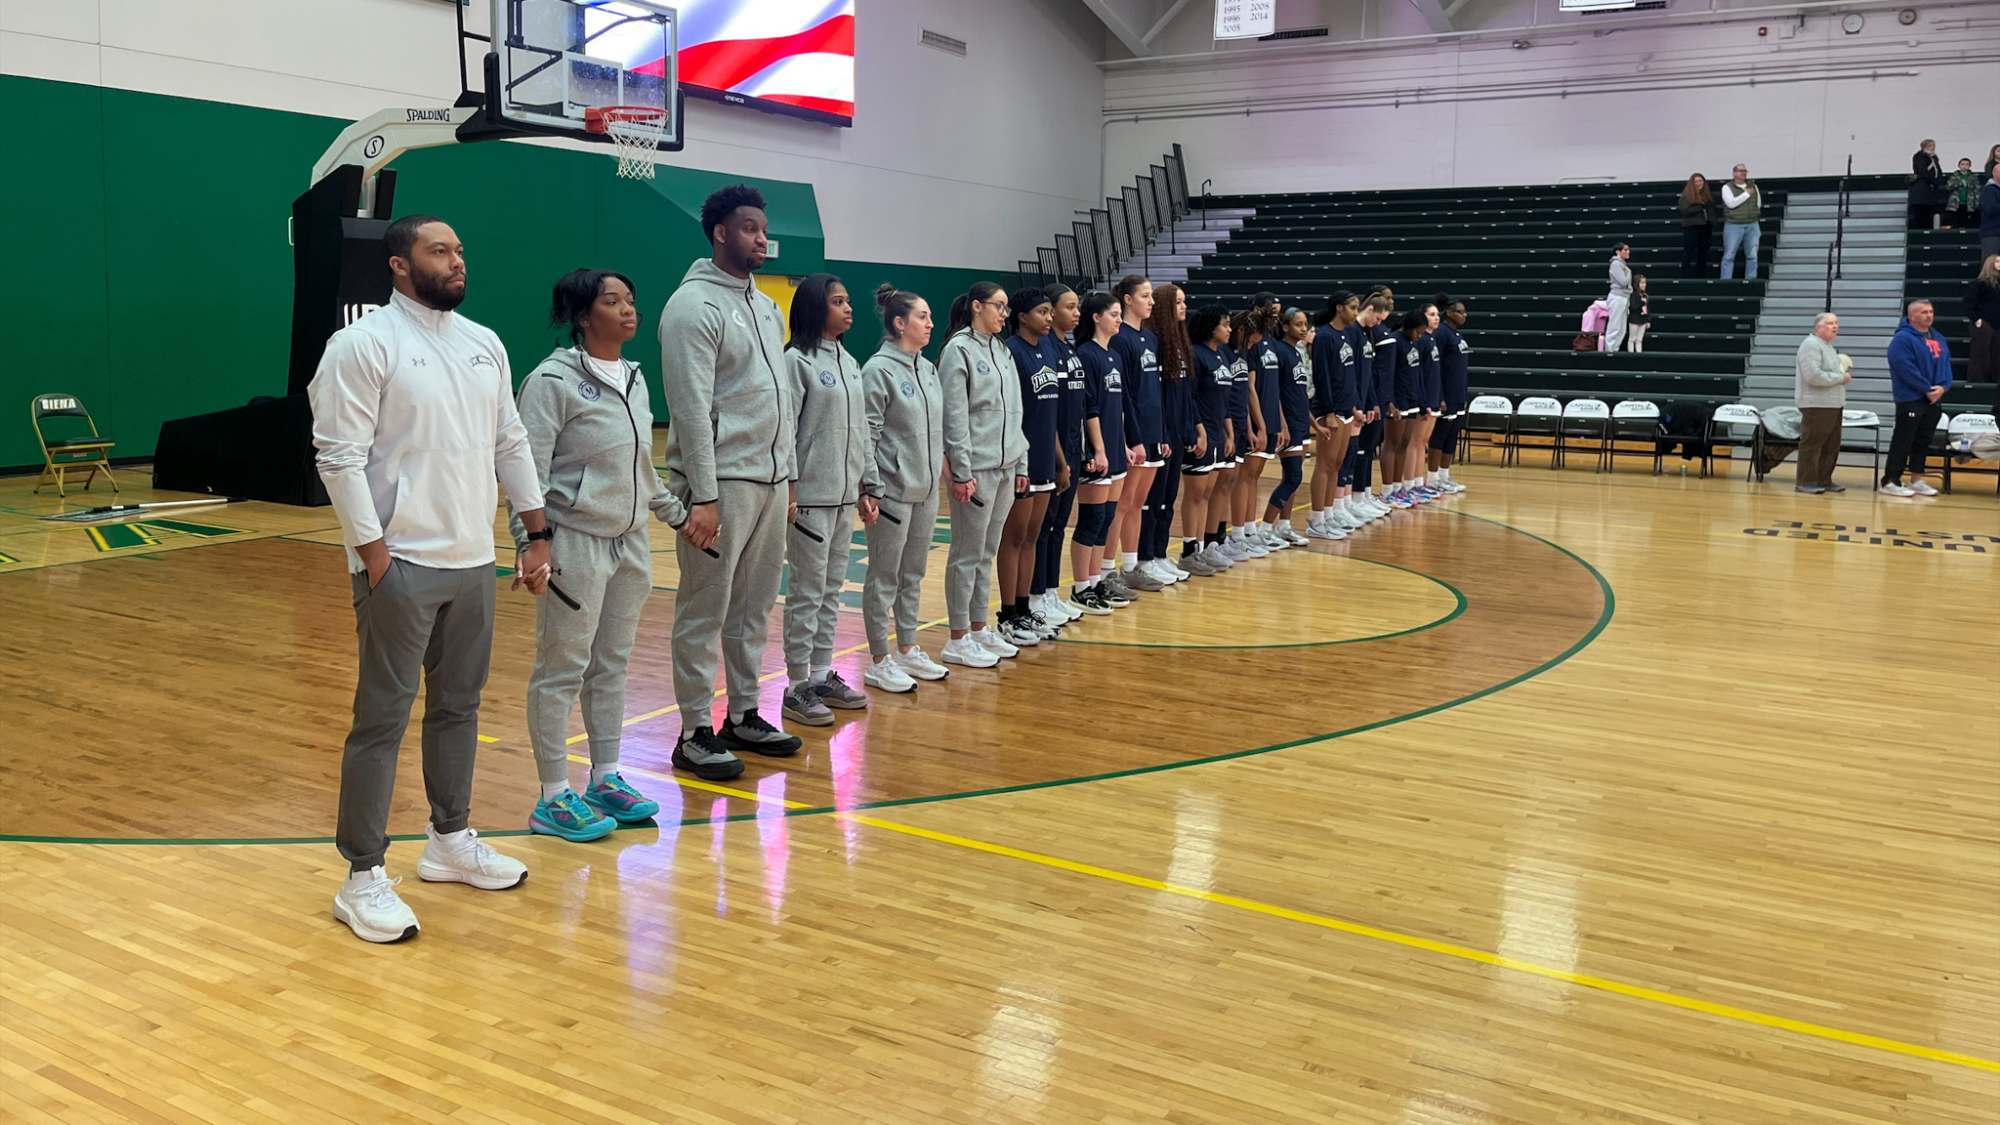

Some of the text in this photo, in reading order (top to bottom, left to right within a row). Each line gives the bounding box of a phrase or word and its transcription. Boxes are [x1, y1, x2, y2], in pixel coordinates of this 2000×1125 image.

[1224, 5, 1240, 14] 1995
[1223, 15, 1240, 24] 1996
[1250, 13, 1268, 21] 2014
[406, 108, 450, 122] SPALDING
[42, 398, 77, 410] SIENA
[1743, 527, 1986, 553] UNITED
